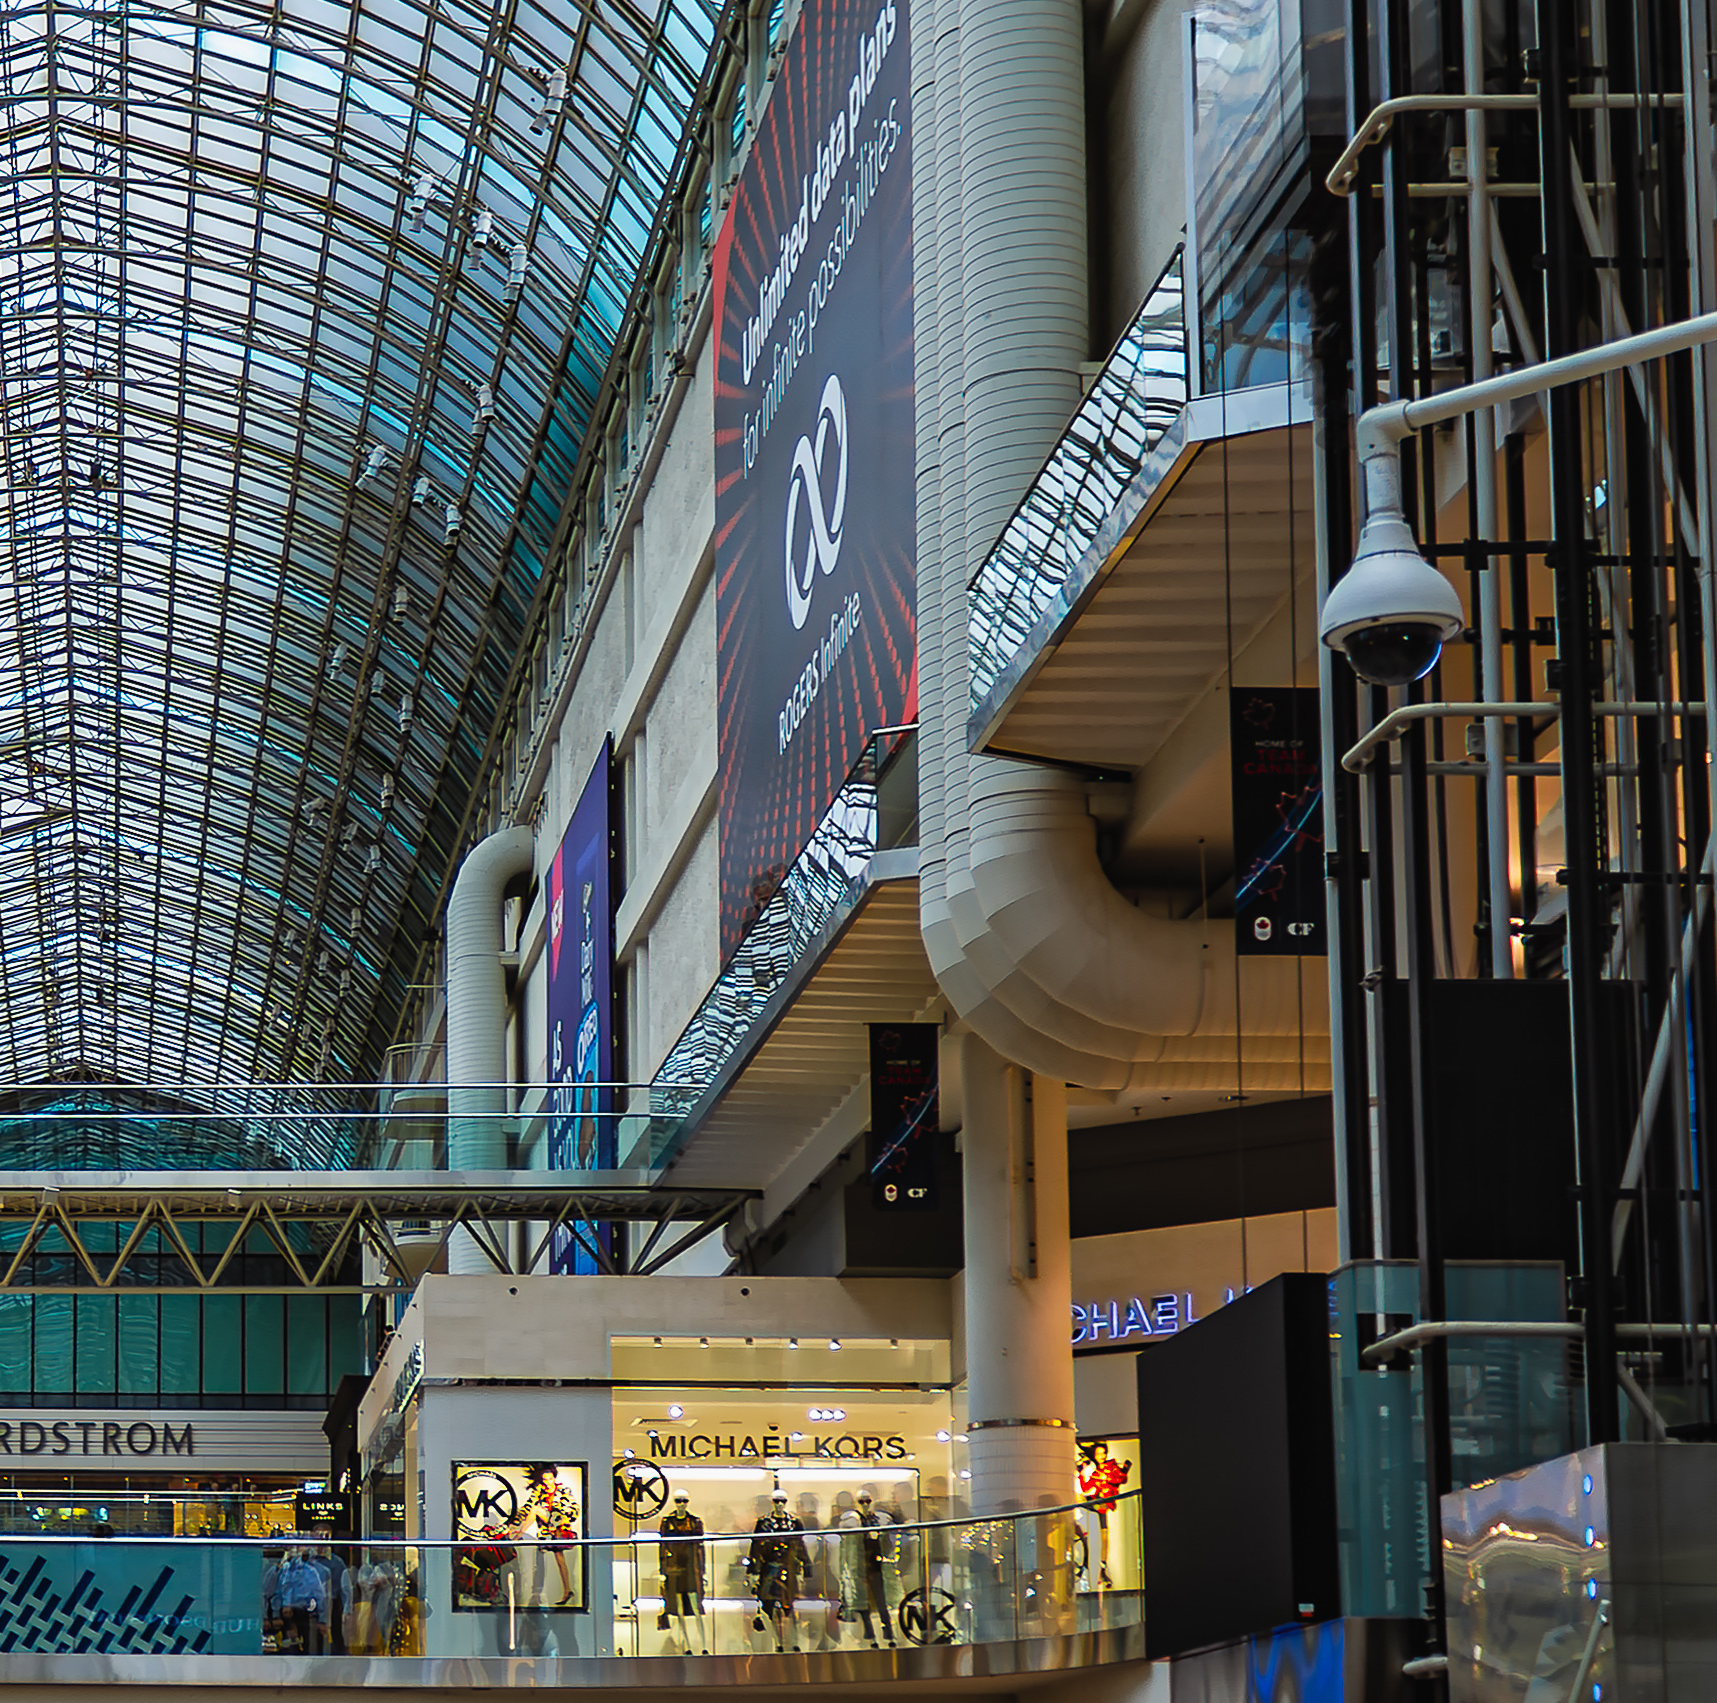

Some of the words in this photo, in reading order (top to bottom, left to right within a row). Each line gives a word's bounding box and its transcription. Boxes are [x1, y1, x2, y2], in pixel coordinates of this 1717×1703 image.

[742, 174, 810, 386] Unlimited
[811, 109, 846, 223] data
[742, 410, 762, 479] for
[761, 309, 807, 438] infinite
[808, 97, 902, 355] possibilities.
[778, 649, 821, 756] ROGERS
[820, 591, 862, 684] Infinite
[302, 1502, 344, 1511] LINKS
[650, 1434, 799, 1459] MICHAEL
[814, 1435, 906, 1460] KORS
